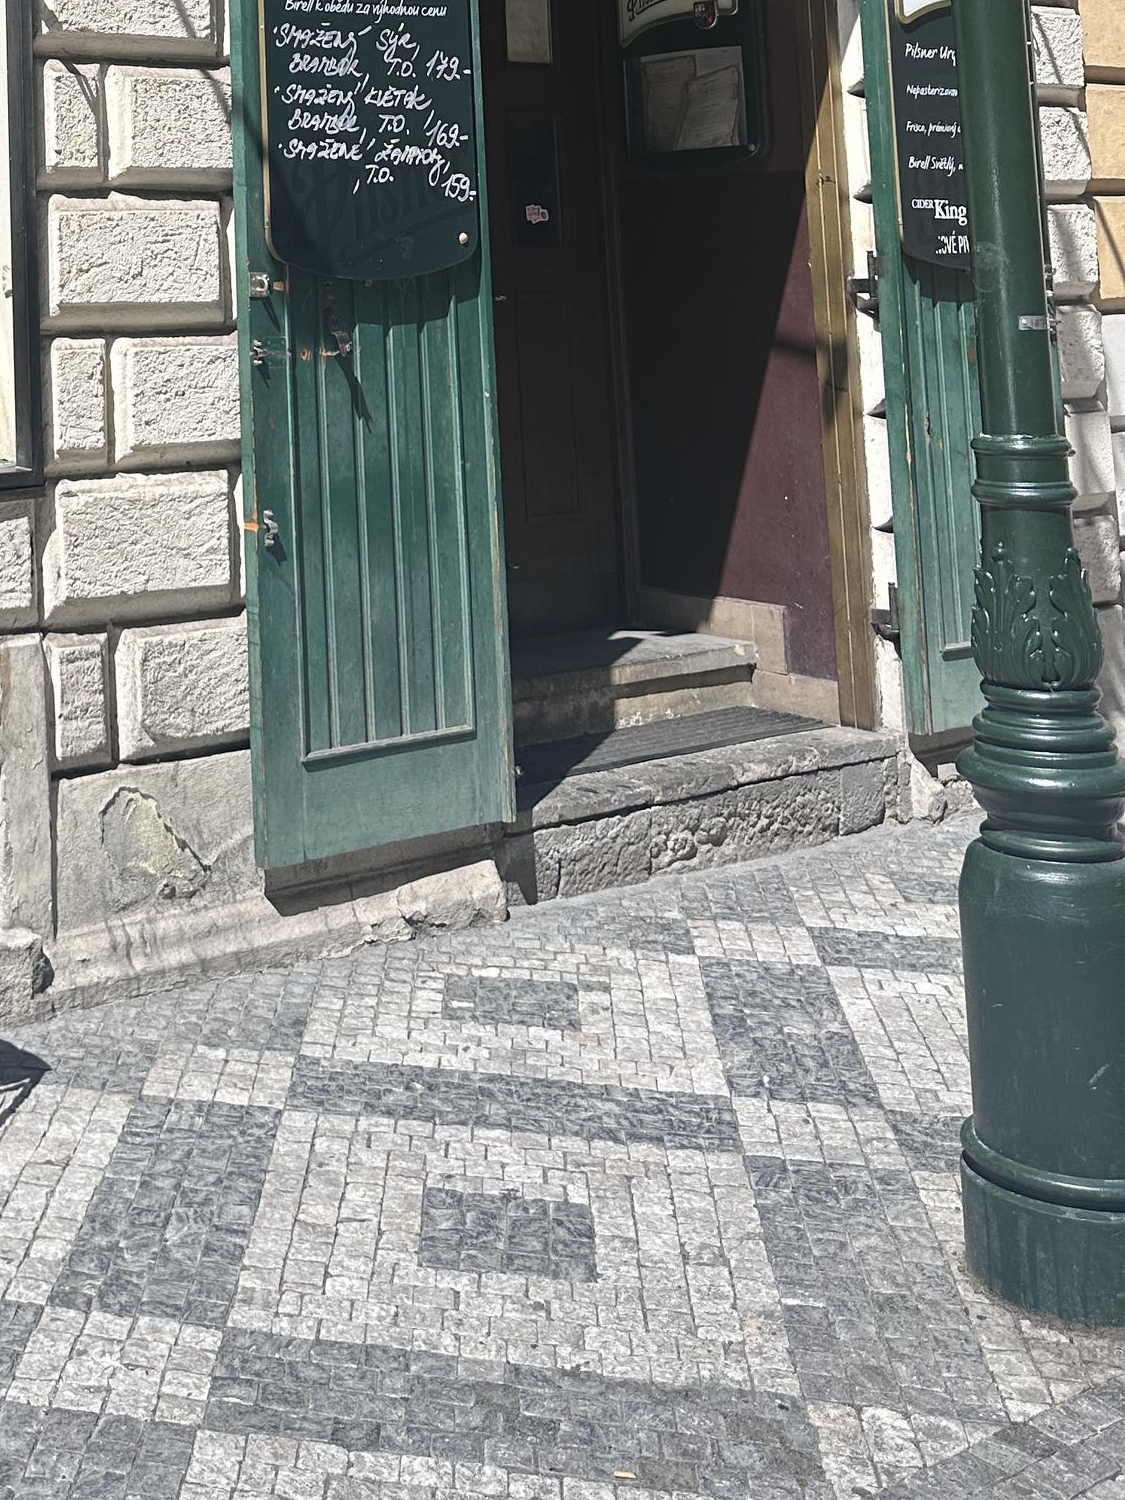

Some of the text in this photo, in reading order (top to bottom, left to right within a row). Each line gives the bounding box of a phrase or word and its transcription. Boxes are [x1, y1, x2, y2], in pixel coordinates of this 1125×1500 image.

[355, 2, 370, 15] za
[421, 5, 447, 18] cenu
[905, 42, 957, 67] Pilsner Urq
[908, 155, 931, 170] Birell
[911, 198, 935, 209] CIDER
